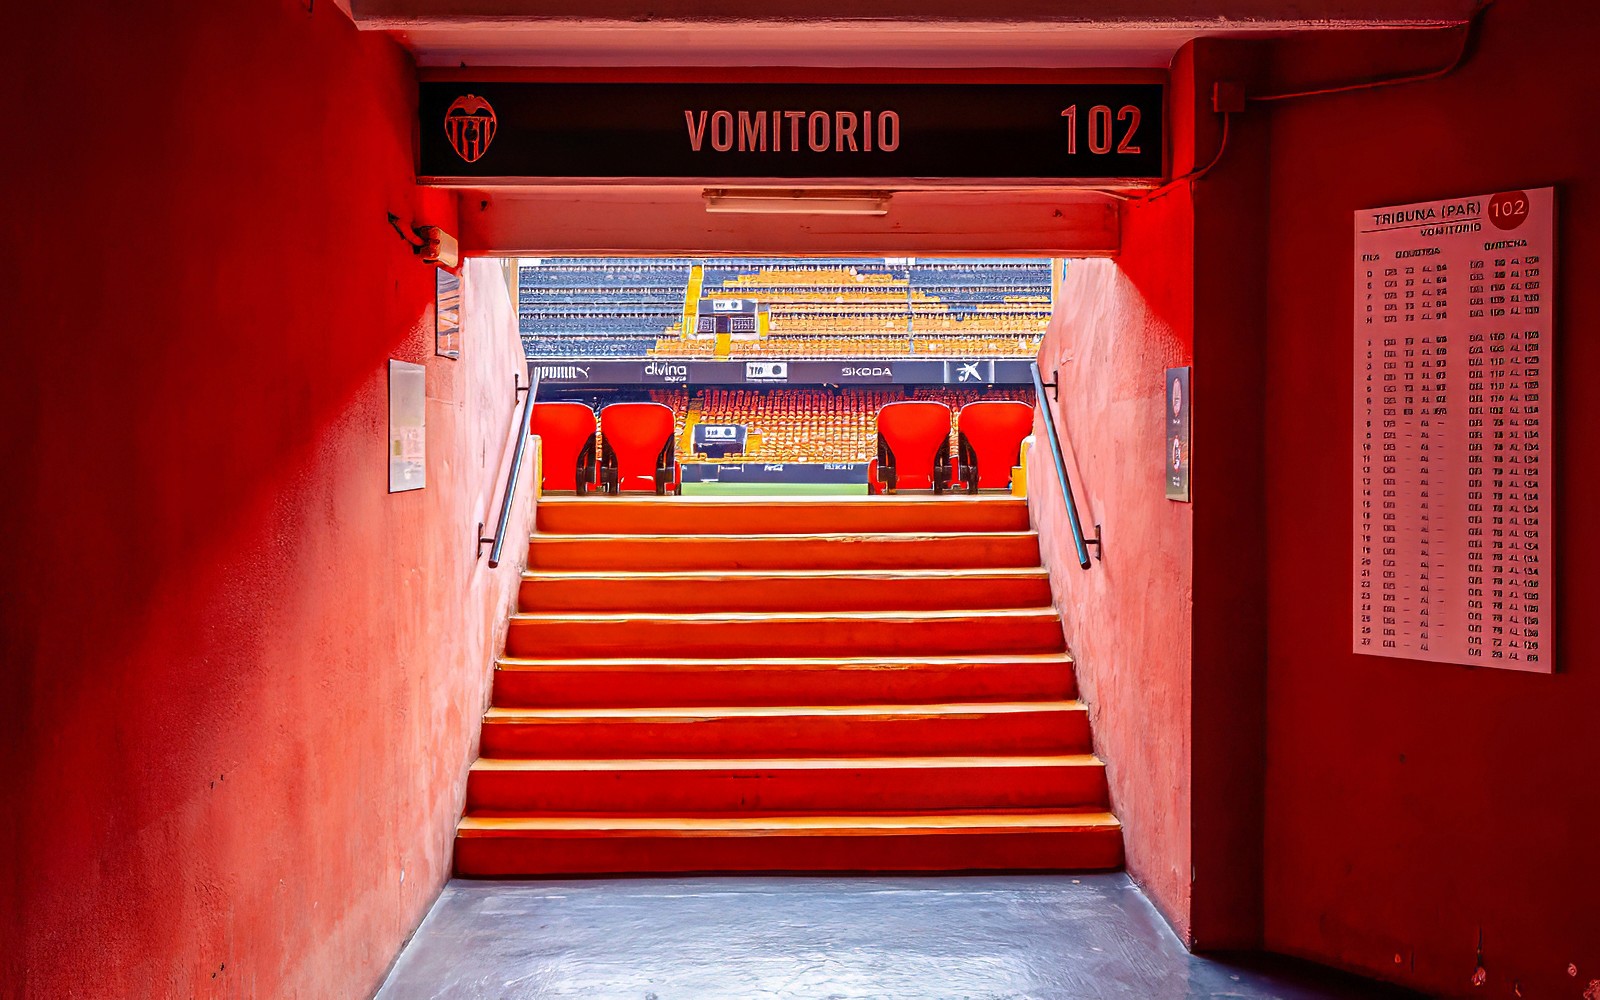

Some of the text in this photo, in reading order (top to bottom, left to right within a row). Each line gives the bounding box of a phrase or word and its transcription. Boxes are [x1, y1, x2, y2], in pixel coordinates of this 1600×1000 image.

[684, 104, 1141, 154] VOMITORIO 102
[1373, 201, 1481, 226] TRIBUNA (PAR)
[1492, 199, 1526, 217] 102
[645, 362, 687, 376] divina
[841, 367, 893, 377] SKODA
